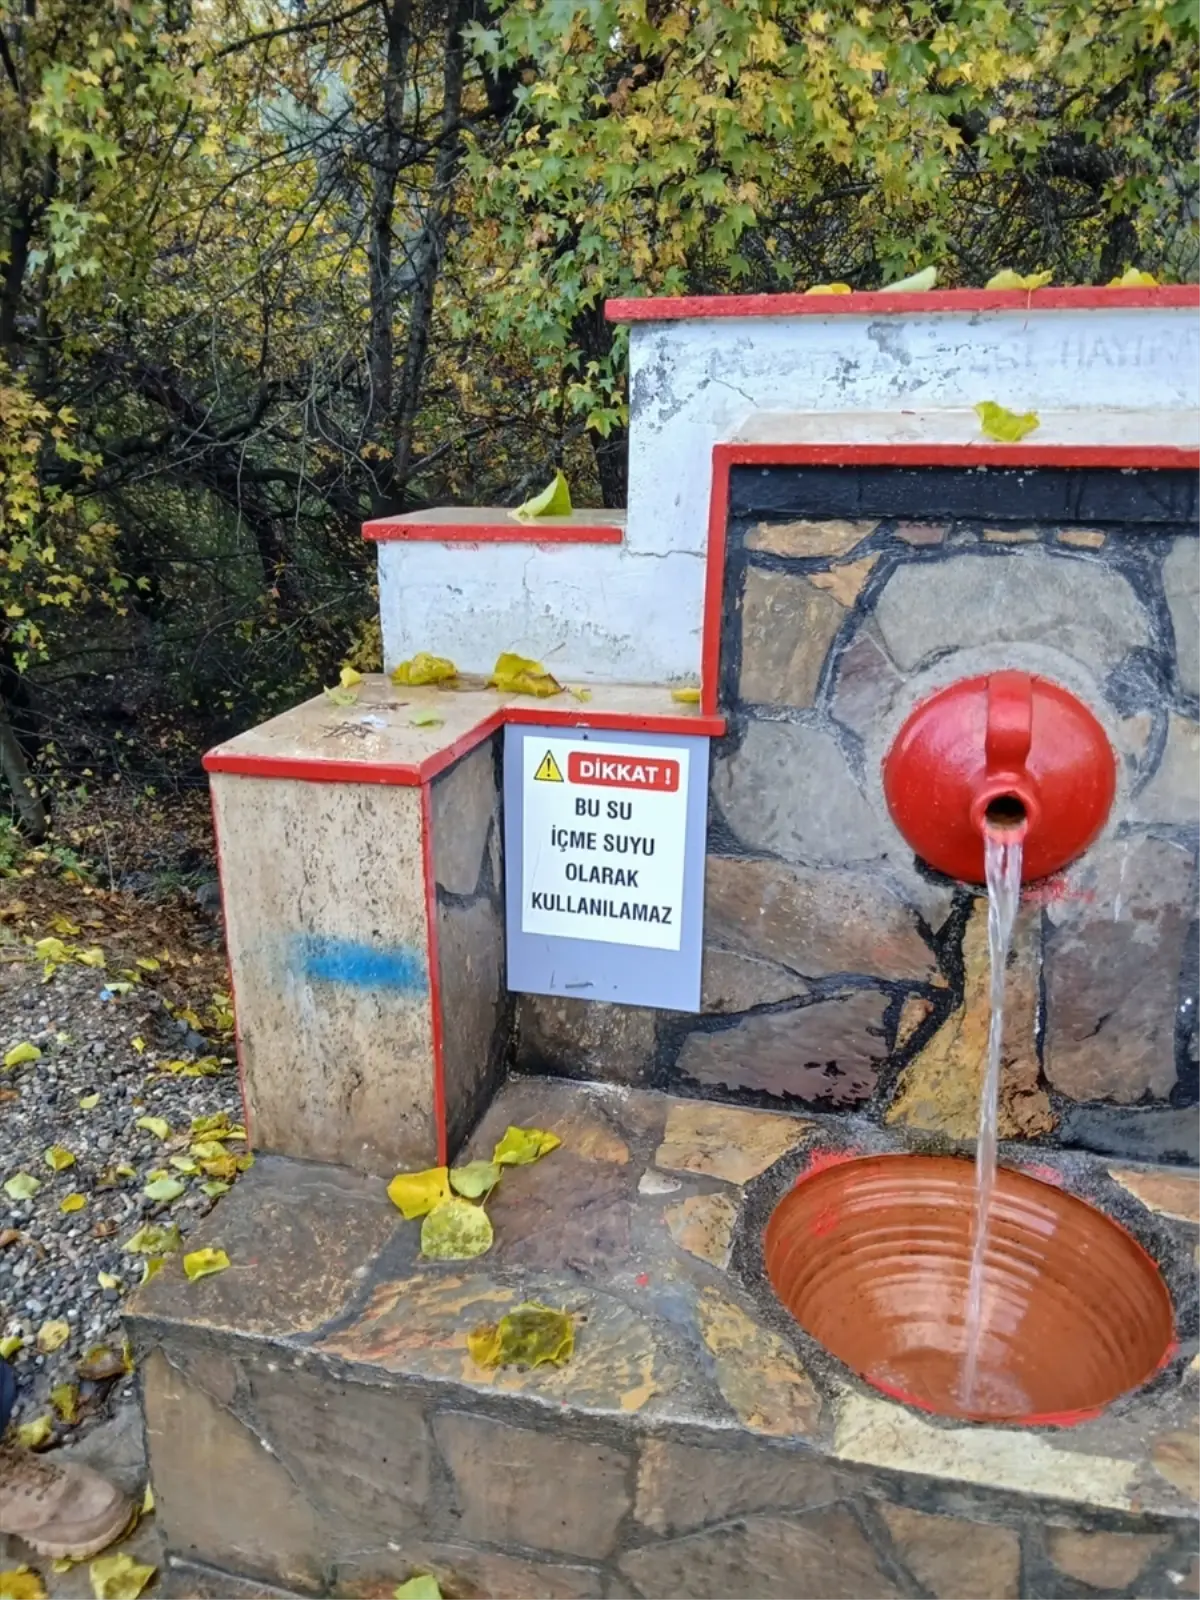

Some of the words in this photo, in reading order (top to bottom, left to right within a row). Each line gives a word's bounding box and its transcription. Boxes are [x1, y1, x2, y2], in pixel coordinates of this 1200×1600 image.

[580, 757, 659, 784] DİKKAT
[664, 767, 673, 785] !
[575, 798, 599, 817] BU
[607, 801, 633, 820] SU
[551, 825, 597, 852] İÇME
[603, 834, 655, 856] SUYU
[565, 863, 640, 887] OLARAK
[532, 892, 673, 925] KULLANILAMAZ
